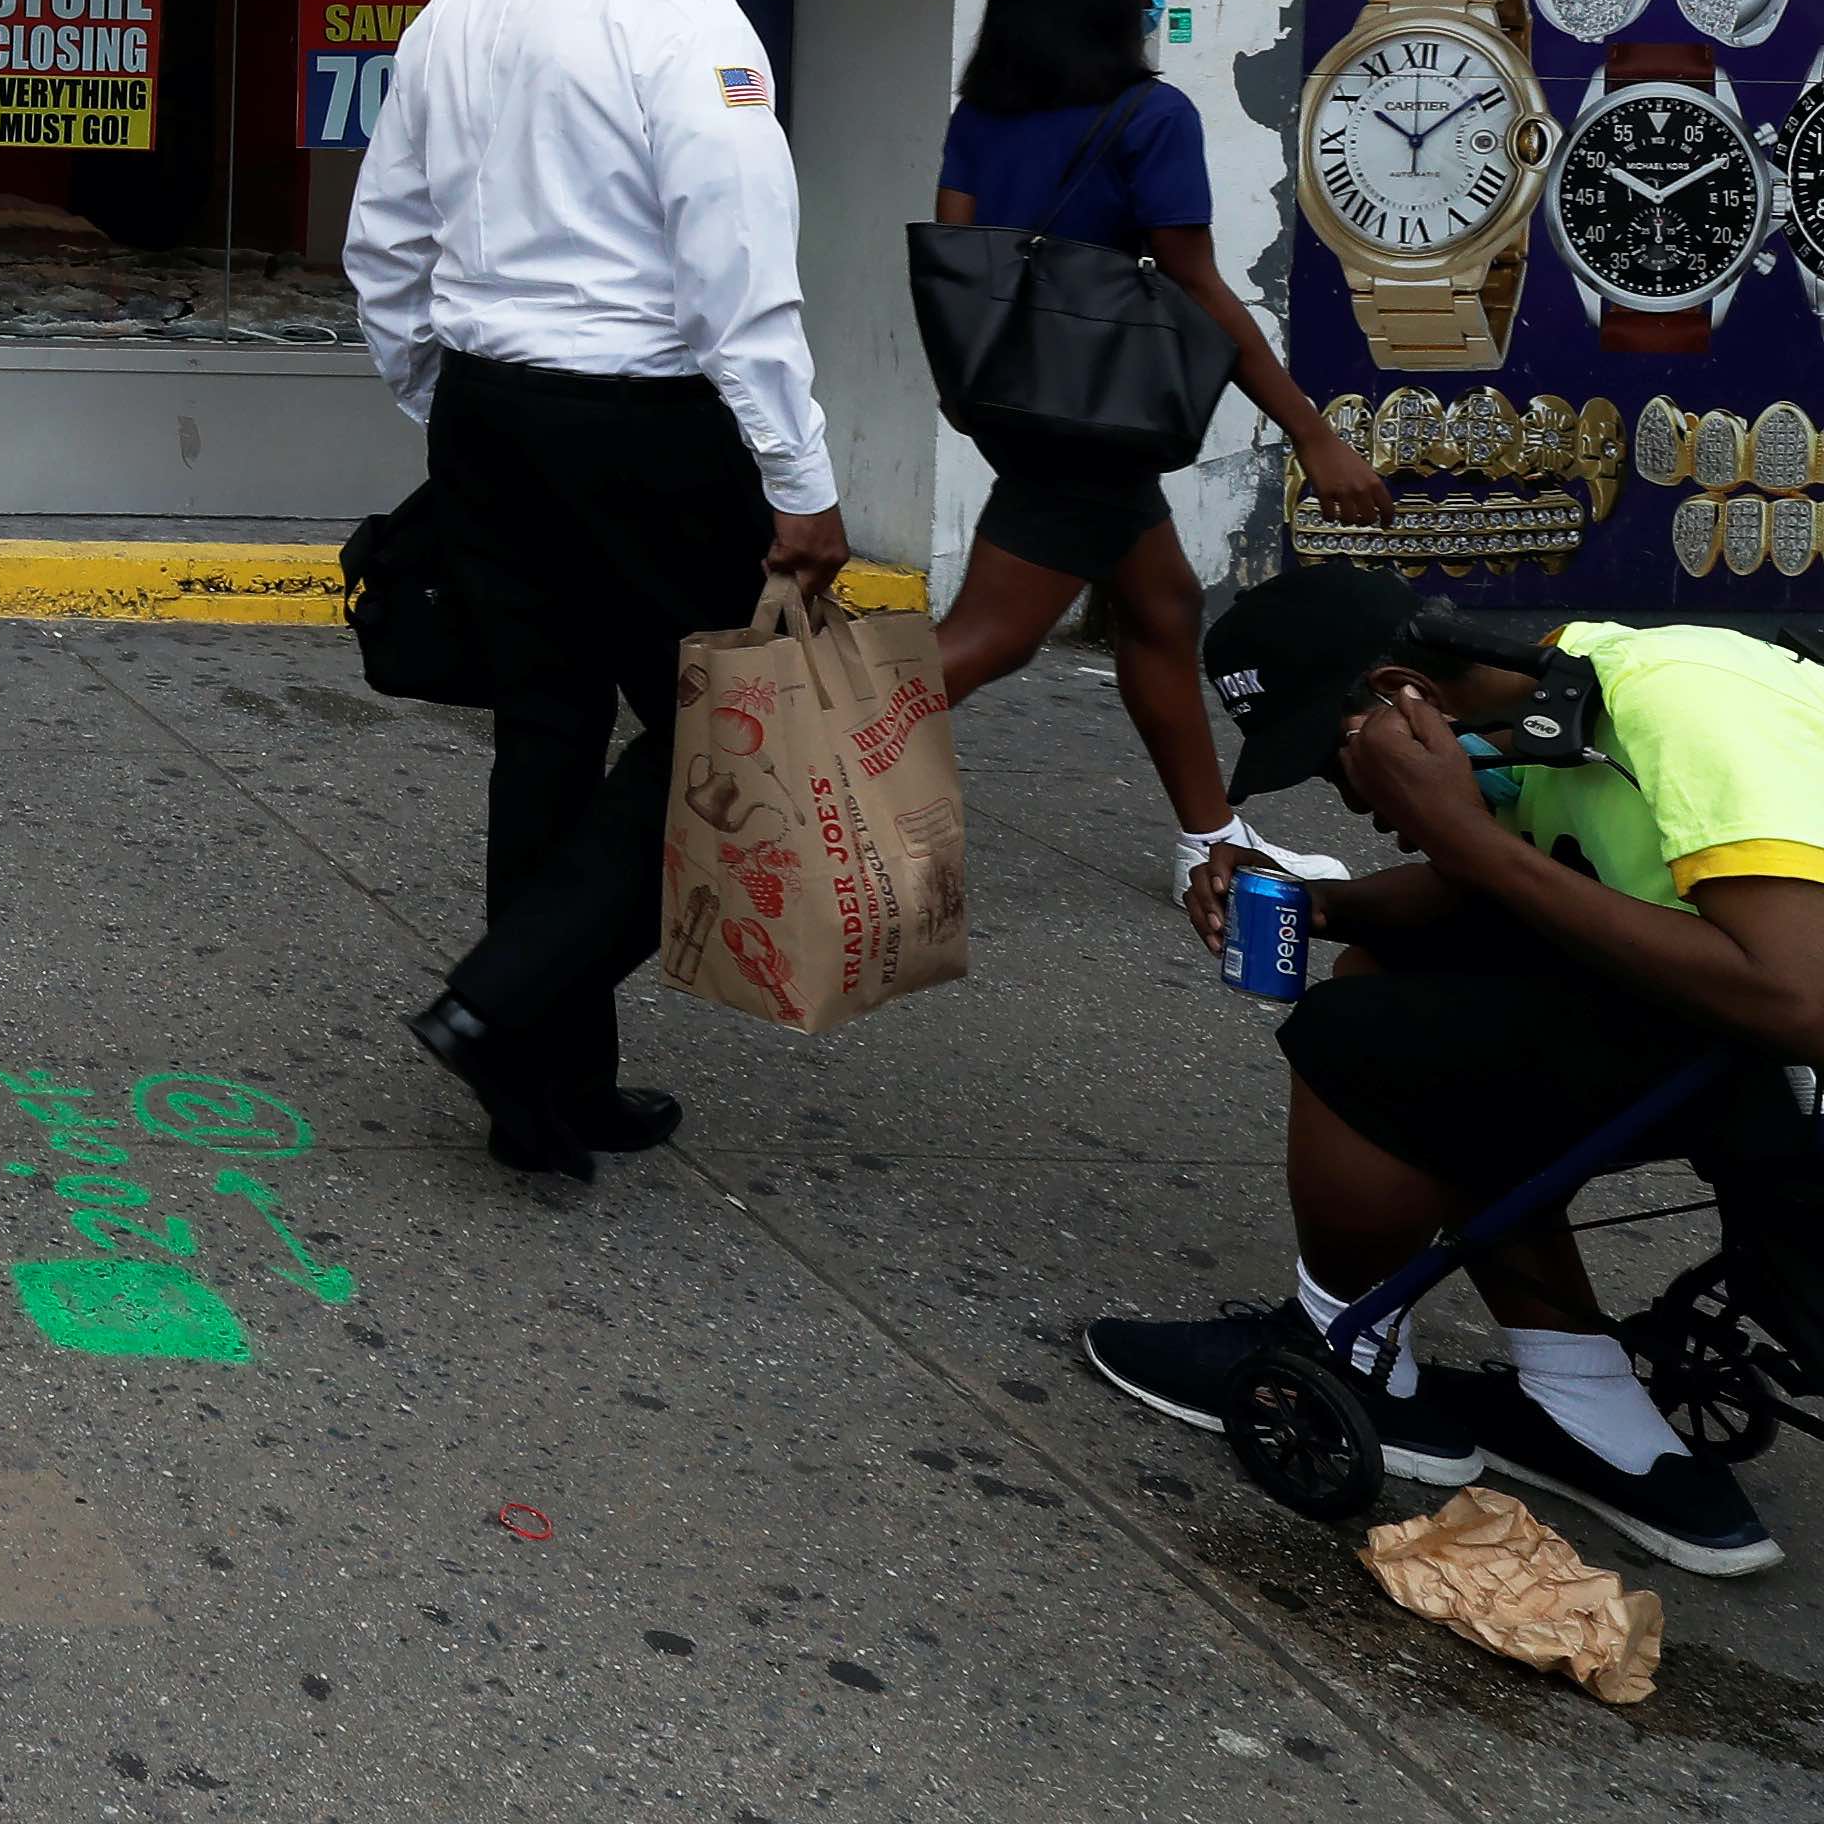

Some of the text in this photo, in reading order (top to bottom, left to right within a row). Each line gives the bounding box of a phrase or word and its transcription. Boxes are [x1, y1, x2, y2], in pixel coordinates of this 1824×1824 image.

[1384, 100, 1451, 112] CARTIER
[82, 113, 130, 147] GO!
[1612, 124, 1634, 142] 55
[1683, 125, 1705, 143] 05
[1585, 151, 1607, 169] 50
[1625, 162, 1691, 172] MICHAEL KORS
[1575, 188, 1596, 206] 45
[1721, 189, 1741, 207] 15
[1584, 225, 1606, 243] 40
[1711, 226, 1733, 244] 20
[1609, 252, 1631, 270] 35
[1687, 253, 1708, 271] 25
[850, 676, 929, 753] REUSABLE
[809, 775, 850, 865] JOE'S
[863, 839, 901, 919] RECYCLE
[832, 874, 865, 995] TRADER
[1275, 906, 1301, 977] pepsi
[881, 923, 902, 986] PLEASE
